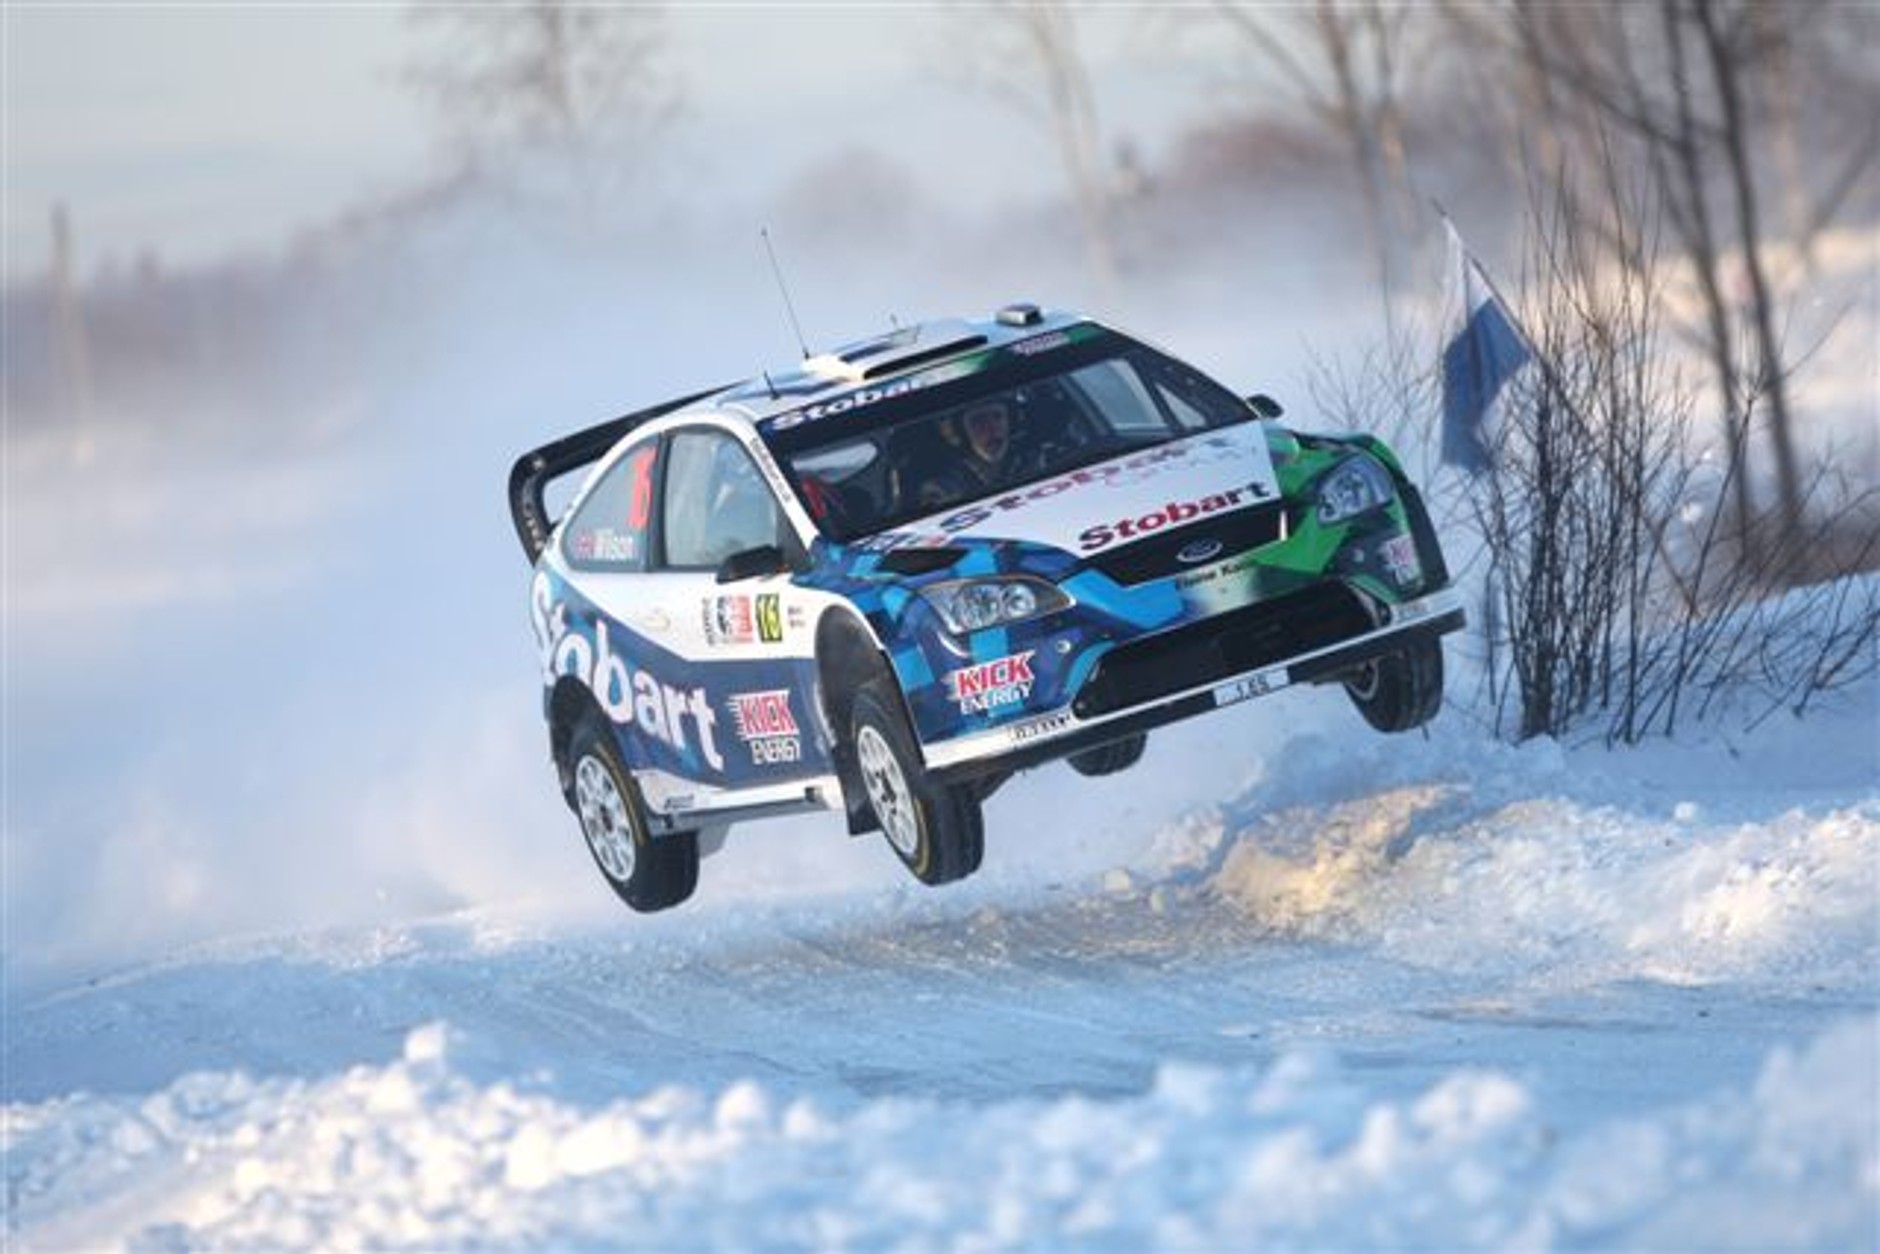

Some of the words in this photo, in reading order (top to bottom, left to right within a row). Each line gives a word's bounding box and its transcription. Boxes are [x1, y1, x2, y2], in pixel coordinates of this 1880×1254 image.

[1078, 481, 1271, 552] Stobart
[531, 571, 725, 772] Stobart
[957, 653, 1034, 696] KICK
[740, 692, 797, 734] KICK
[960, 681, 1033, 715] ENERGY
[751, 738, 800, 765] ENERGY
